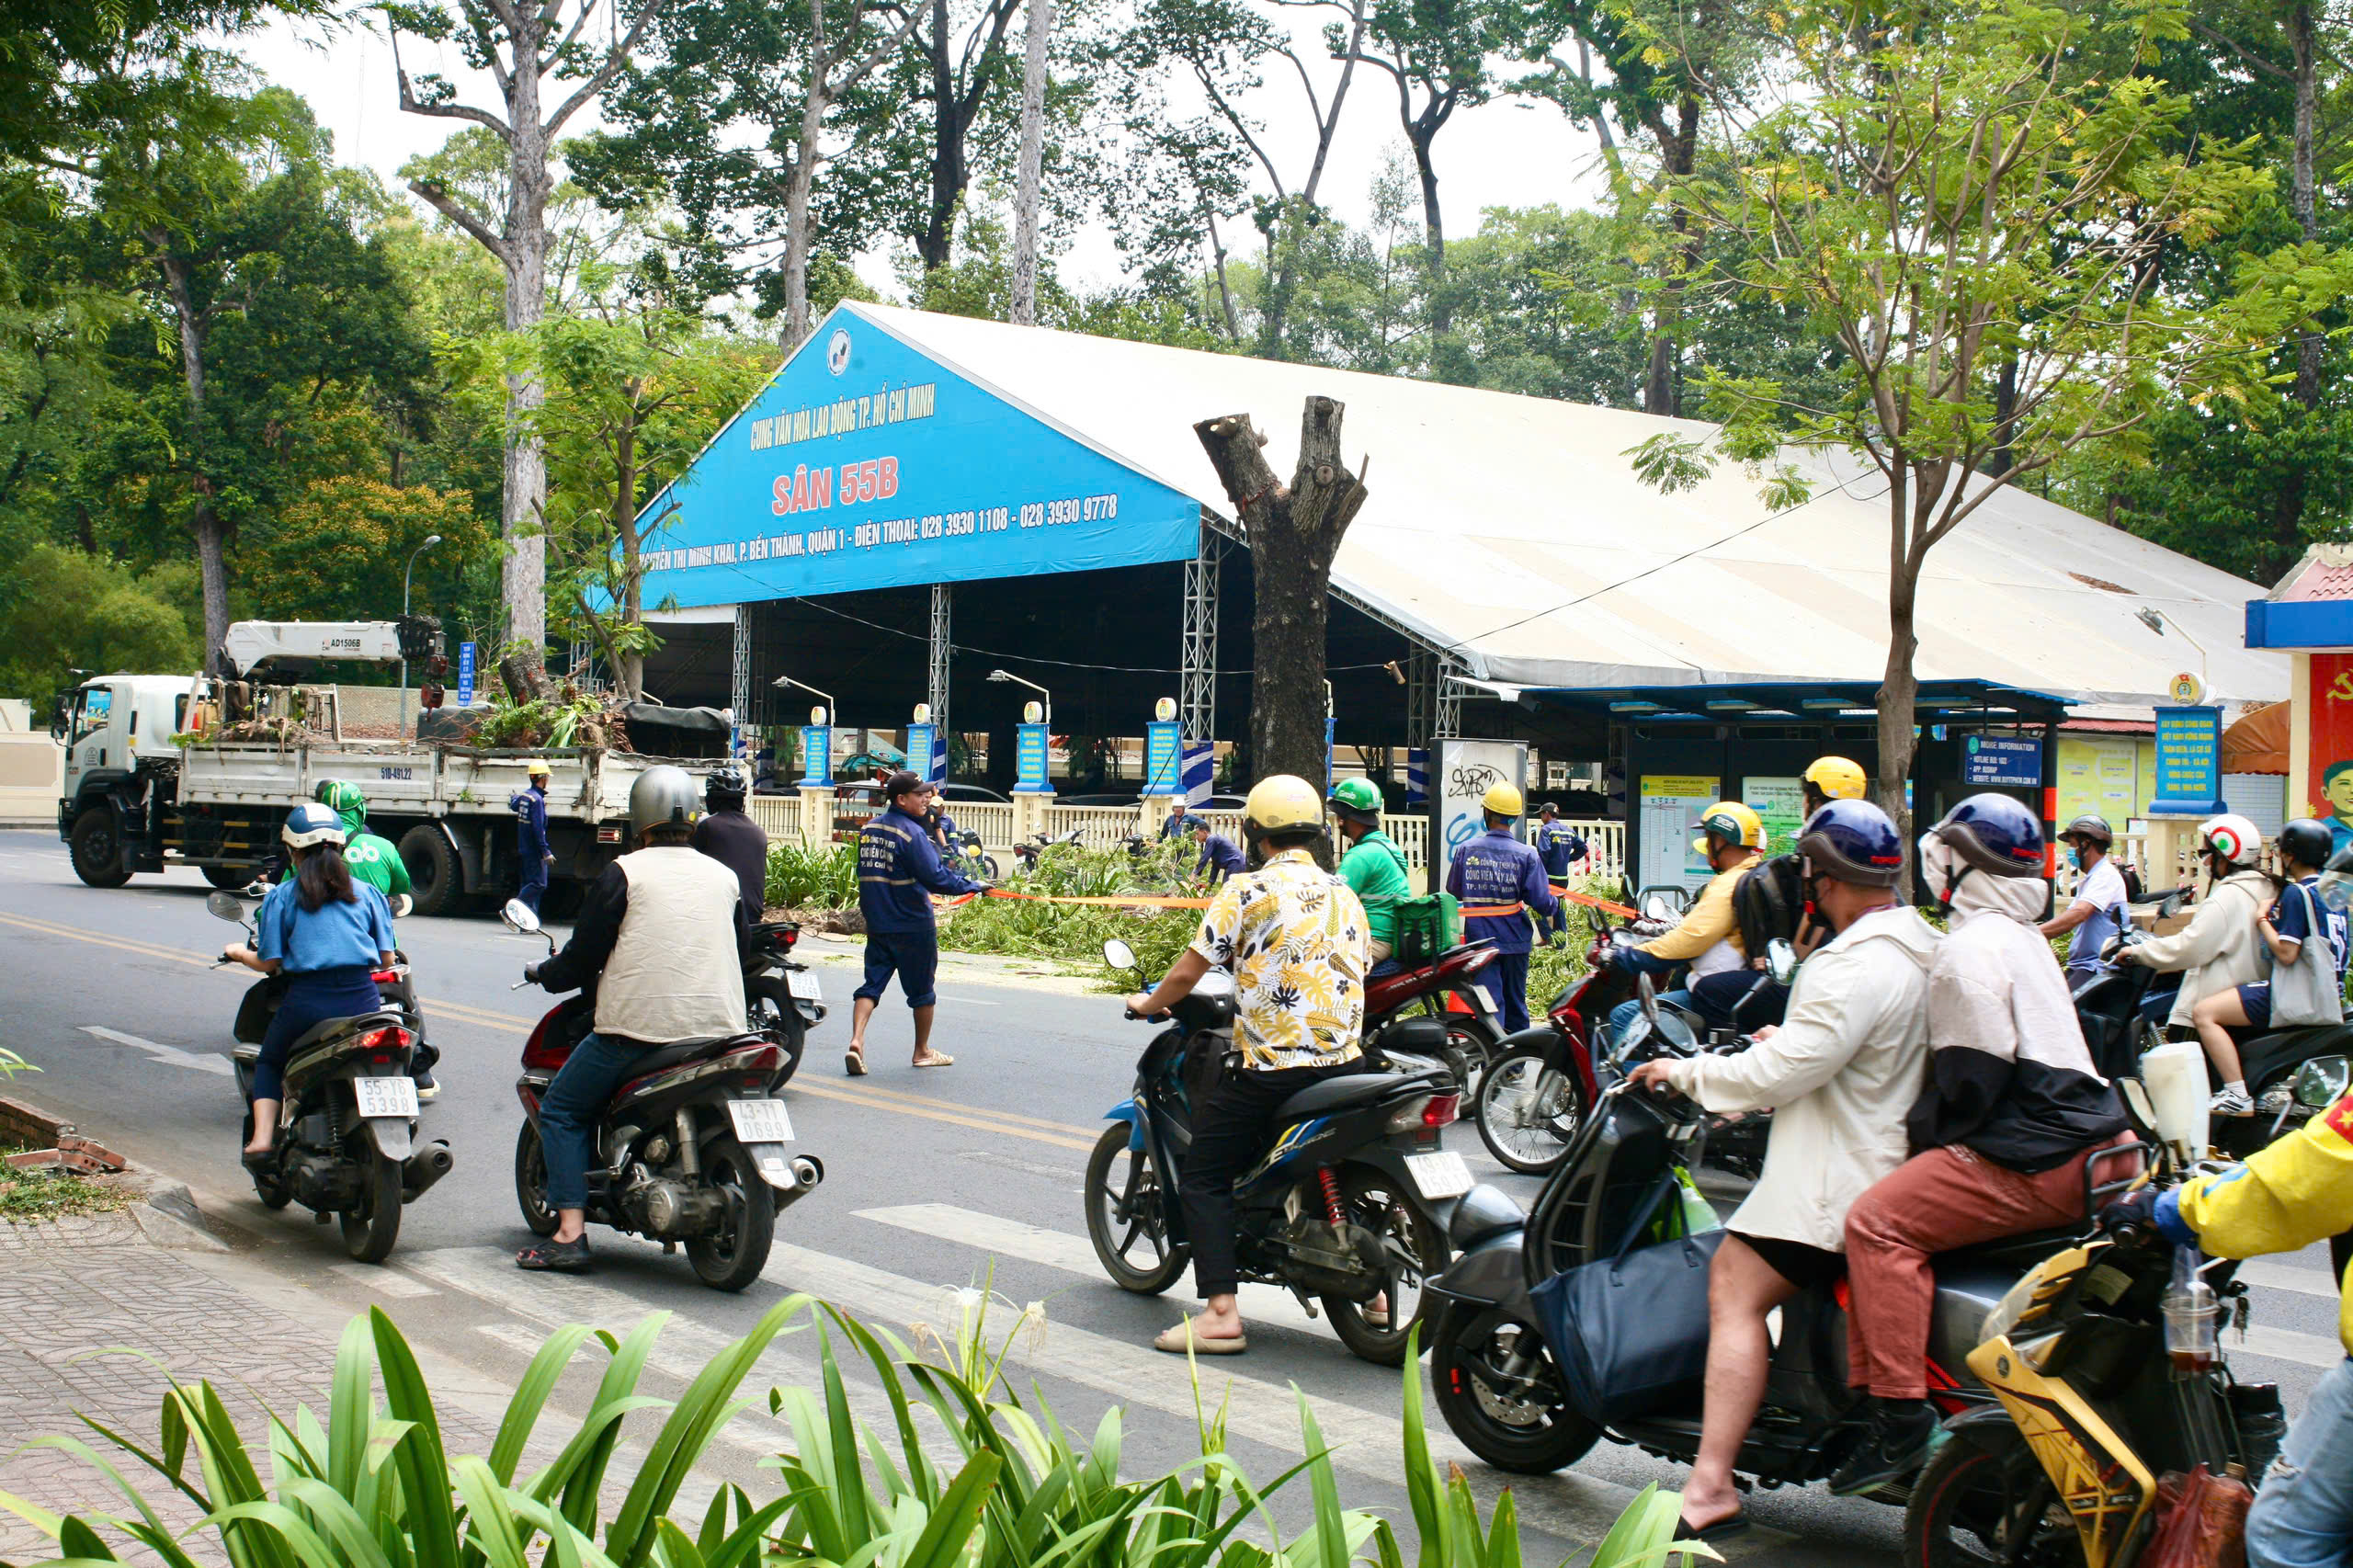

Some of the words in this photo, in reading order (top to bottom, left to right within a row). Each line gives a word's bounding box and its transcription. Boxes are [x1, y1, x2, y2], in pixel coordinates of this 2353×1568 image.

[750, 417, 773, 452] CUNG
[774, 407, 792, 447] VĂN
[793, 403, 811, 444] HÓA
[813, 403, 829, 439] LAO
[830, 393, 856, 441] ĐỘNG
[858, 395, 870, 430] TP.
[872, 380, 888, 426] HỒ
[888, 381, 907, 424] CHÍ
[906, 382, 936, 421] MINH
[772, 463, 832, 516] SÂN
[839, 456, 898, 506] 55B
[673, 550, 687, 573] THỊ
[688, 545, 711, 567] MINH
[739, 542, 748, 562] P.
[749, 531, 769, 562] BẾN
[770, 531, 805, 558] THÀNH,
[808, 525, 836, 557] QUẬN
[838, 528, 845, 551] 1
[854, 516, 881, 551] ĐIỆN
[882, 517, 918, 546] THOẠI:
[921, 515, 942, 540] 028
[945, 510, 975, 537] 3930
[978, 506, 1008, 533] 1108
[1019, 502, 1044, 528] 028
[1047, 498, 1080, 525] 3930
[1083, 493, 1118, 522] 9778
[331, 639, 360, 648] AD1506B
[1981, 741, 1997, 749] MORE
[1998, 742, 2035, 752] INFORMATION
[381, 767, 412, 779] 51D-491.22
[345, 840, 380, 863] ab
[364, 1080, 406, 1096] 55-Y6
[368, 1096, 410, 1114] 5398
[744, 1121, 784, 1139] 0699
